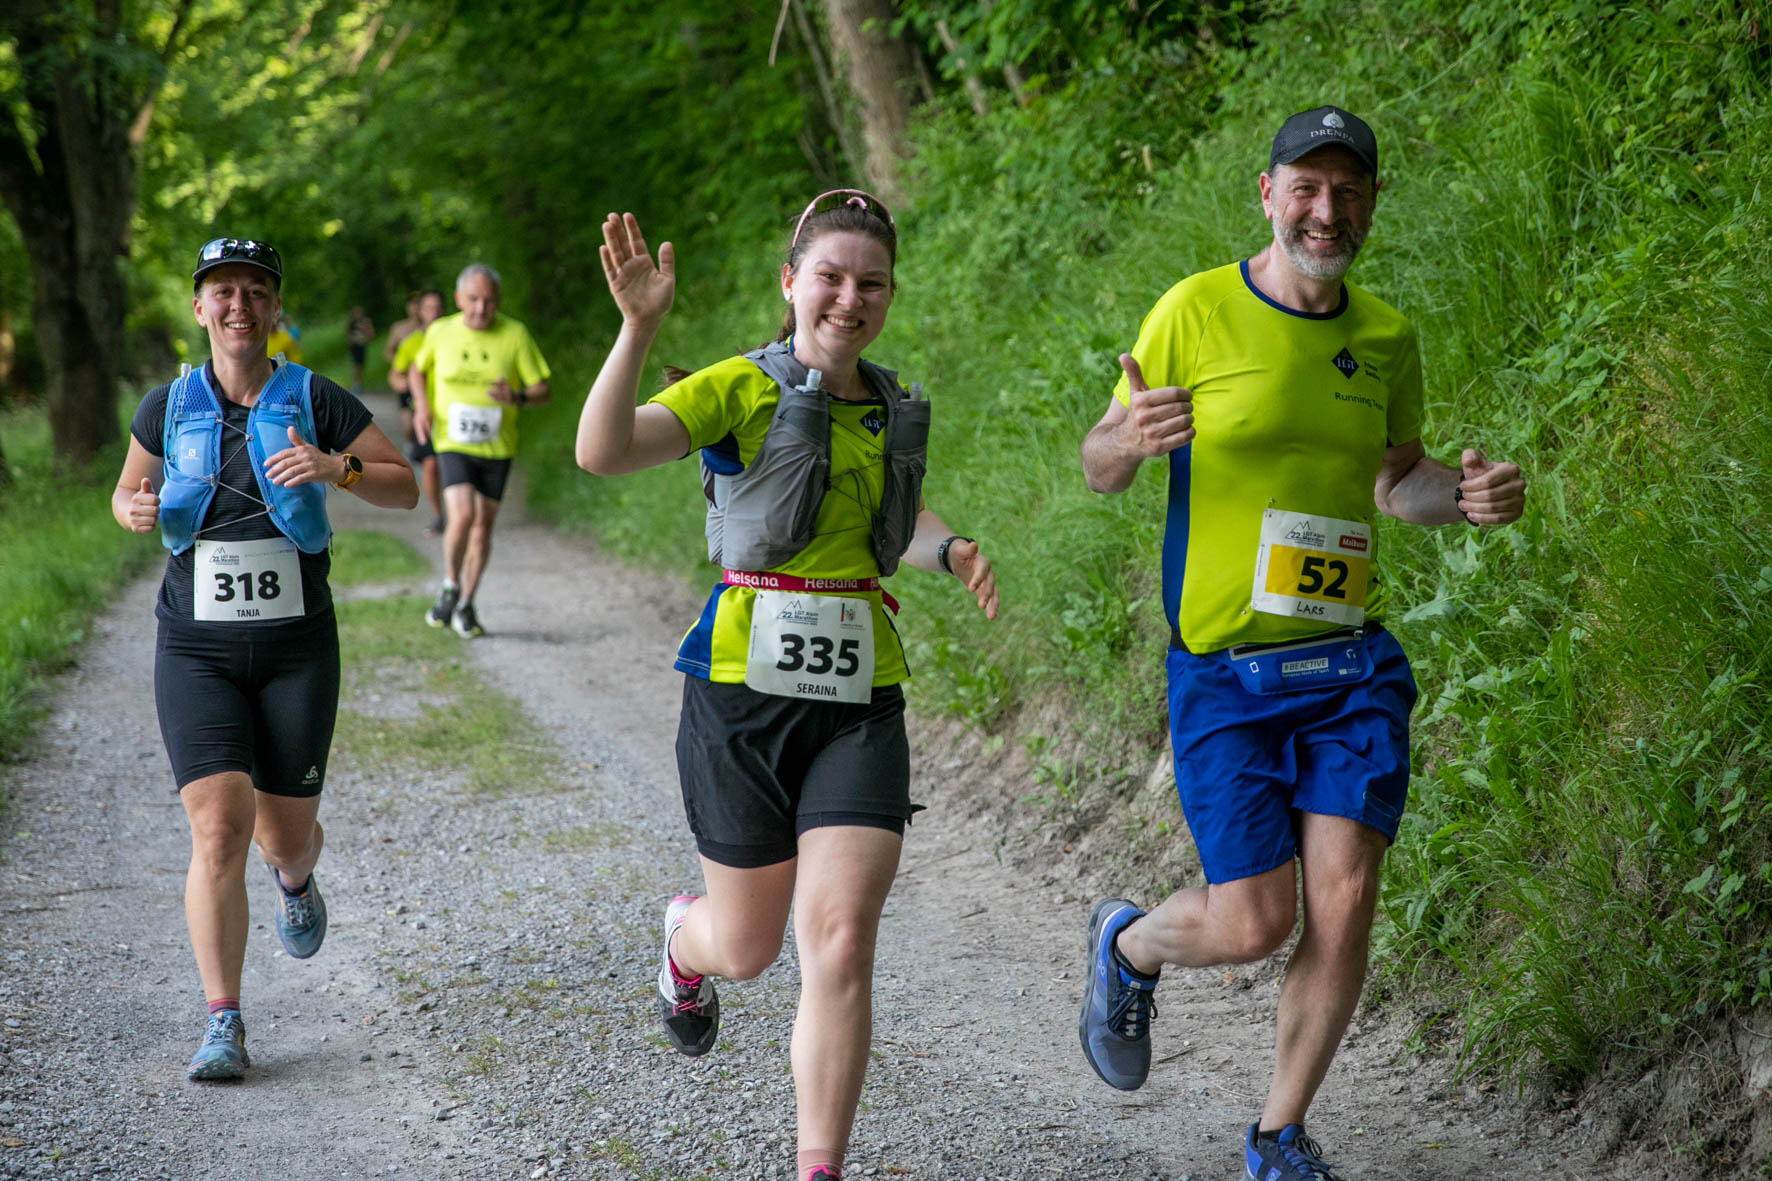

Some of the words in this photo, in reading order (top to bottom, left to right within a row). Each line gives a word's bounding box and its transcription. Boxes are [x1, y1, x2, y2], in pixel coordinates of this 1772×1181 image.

[1335, 392, 1372, 408] Running
[214, 570, 281, 602] 318
[728, 570, 779, 588] Helsana
[804, 577, 858, 589] Helsana
[1297, 556, 1349, 599] 52
[236, 608, 261, 618] TANJA
[1297, 601, 1326, 616] LARS
[776, 633, 860, 677] 335
[796, 683, 837, 697] SERAINA
